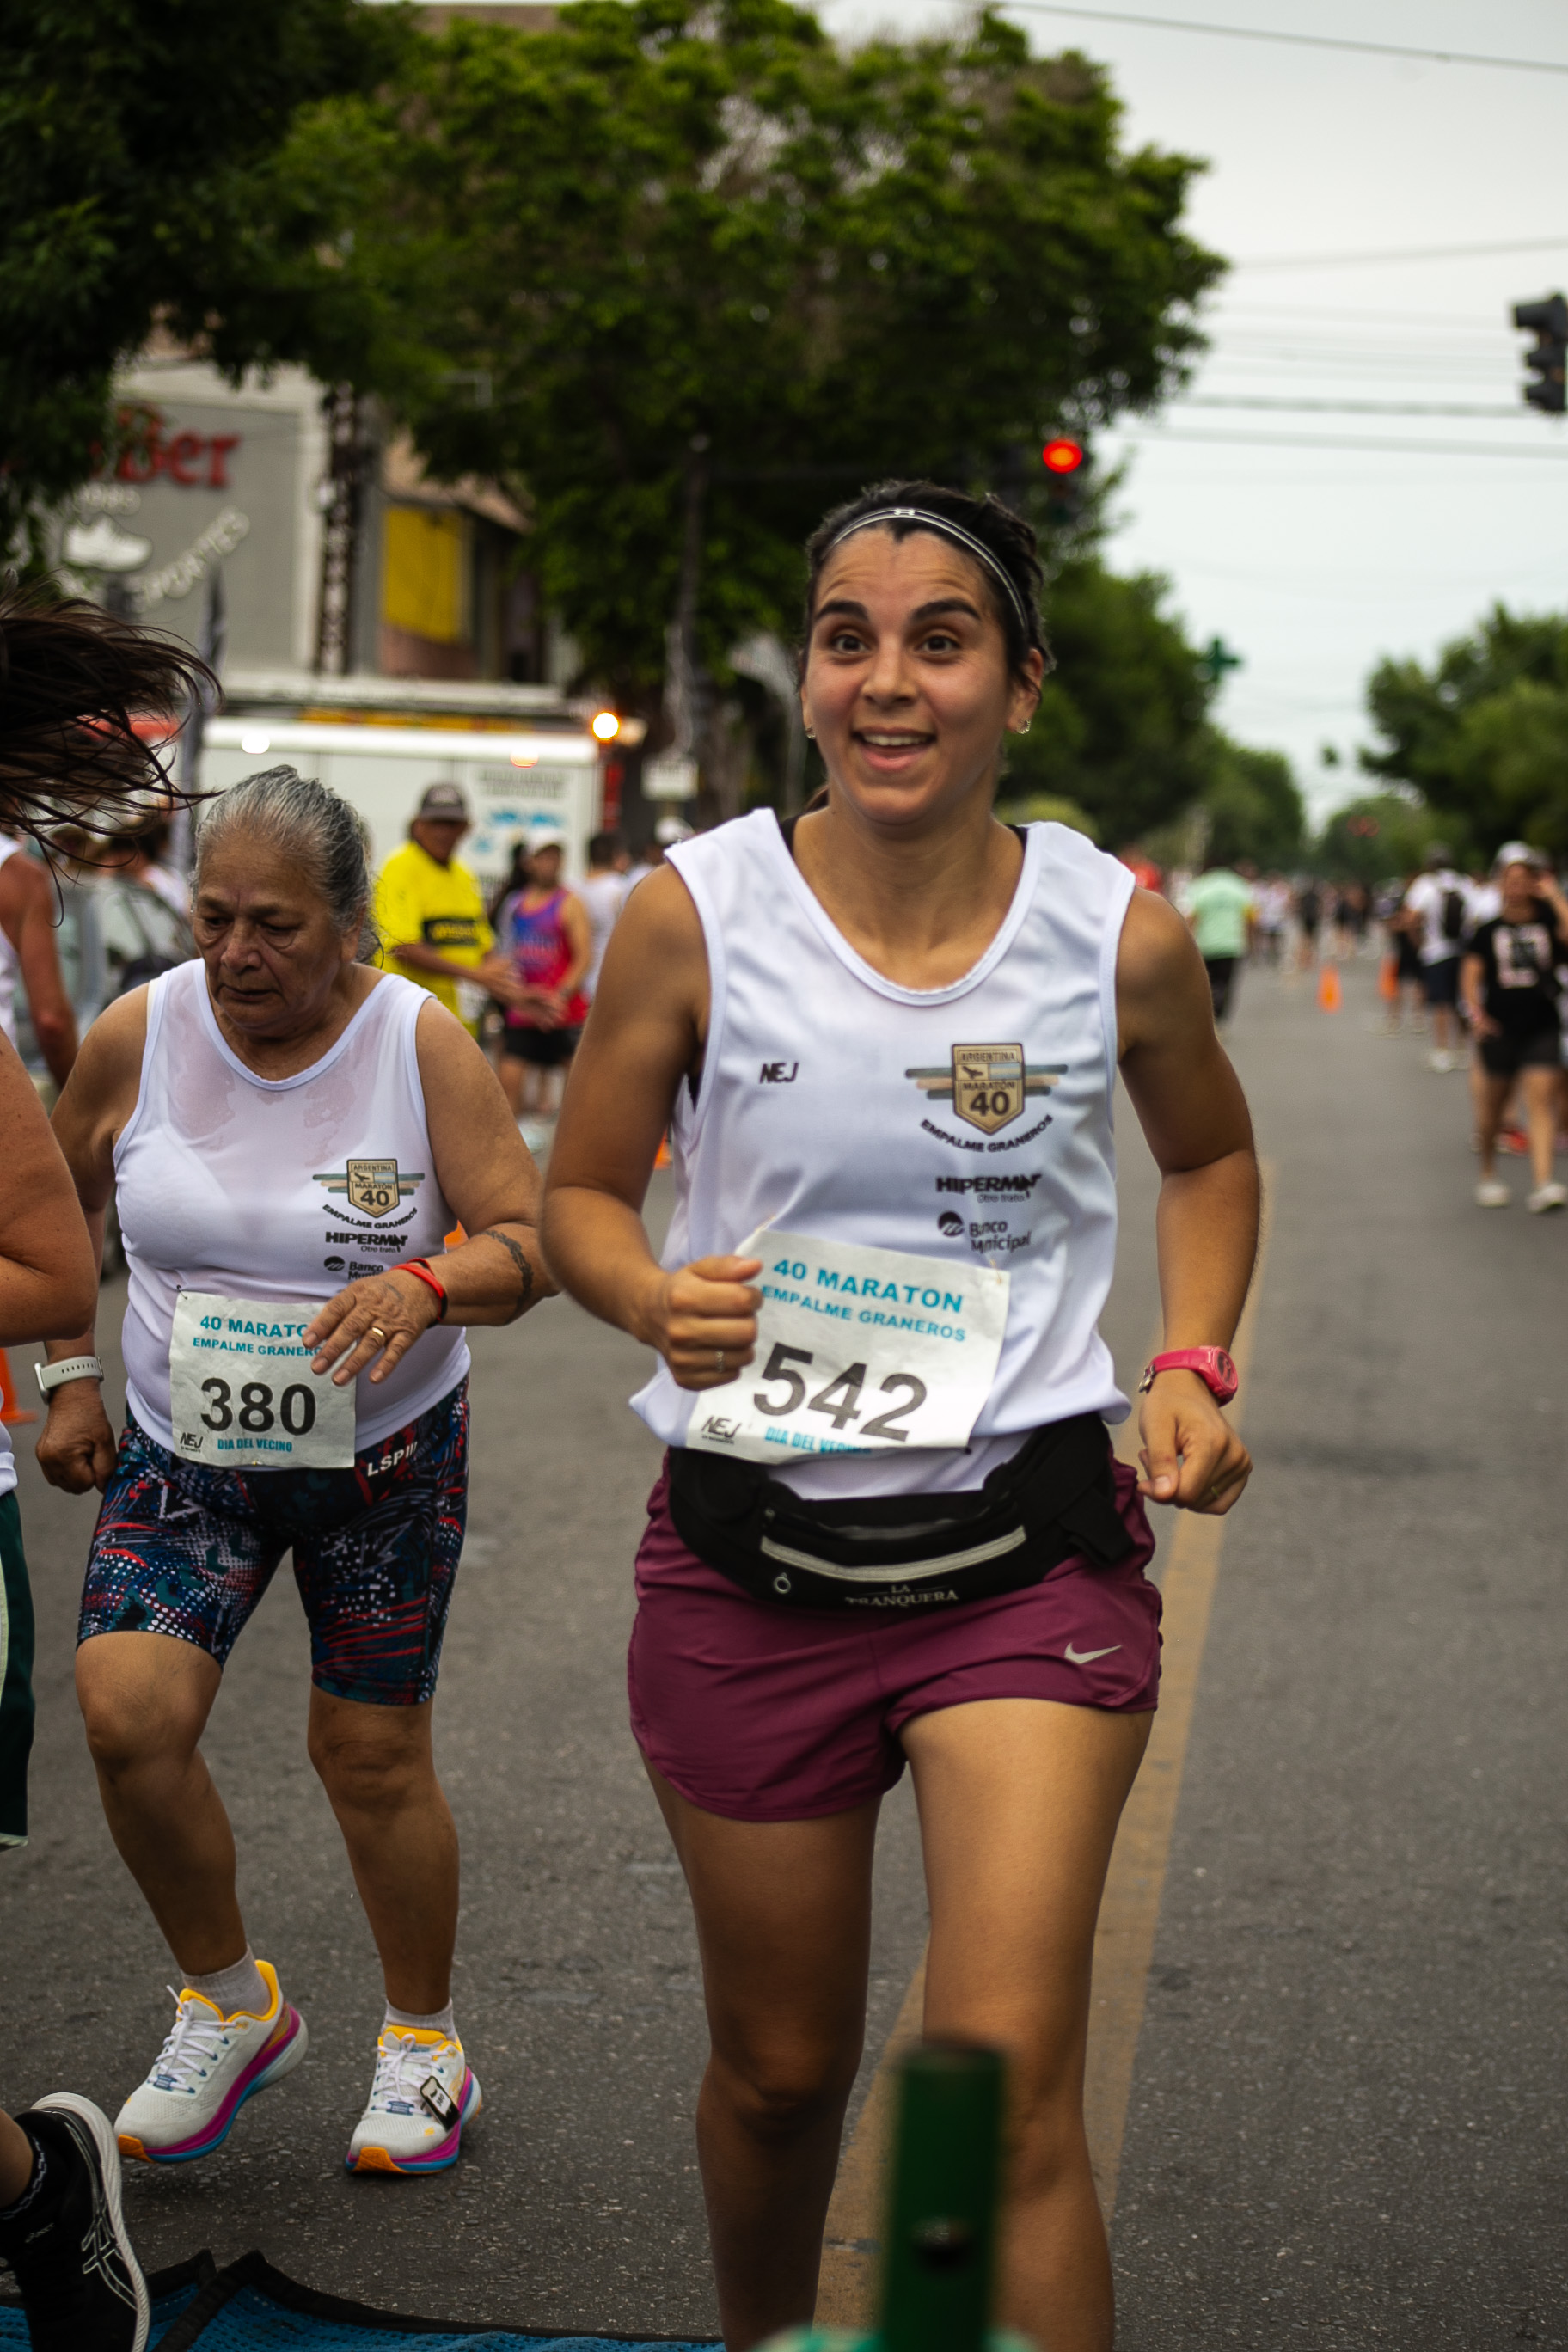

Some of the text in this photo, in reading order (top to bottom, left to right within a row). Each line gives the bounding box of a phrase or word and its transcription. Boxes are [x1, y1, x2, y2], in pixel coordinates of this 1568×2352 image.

[960, 1052, 1014, 1063] ARGENTINA
[759, 1062, 799, 1084] NEJ
[970, 1092, 1010, 1116] 40
[920, 1114, 1054, 1153] EMPALME GRANEROS
[360, 1190, 390, 1207] 40
[322, 1204, 418, 1230] EMPALME GRANEROS
[349, 1261, 385, 1273] Banco
[774, 1259, 964, 1313] 40 MARATON
[762, 1285, 966, 1342] EMPALME GRANEROS
[200, 1315, 308, 1338] 40 MARATO
[193, 1337, 322, 1357] EMPALME GRANERO
[754, 1342, 928, 1442] 542
[200, 1377, 316, 1436] 380
[701, 1415, 743, 1439] NEJ
[764, 1425, 787, 1445] DIA
[791, 1431, 815, 1452] DEL
[180, 1432, 204, 1449] NEJ
[217, 1437, 293, 1453] DIA DEL VECINO
[845, 1589, 959, 1607] TRANQUERA
[891, 1584, 910, 1594] LA
